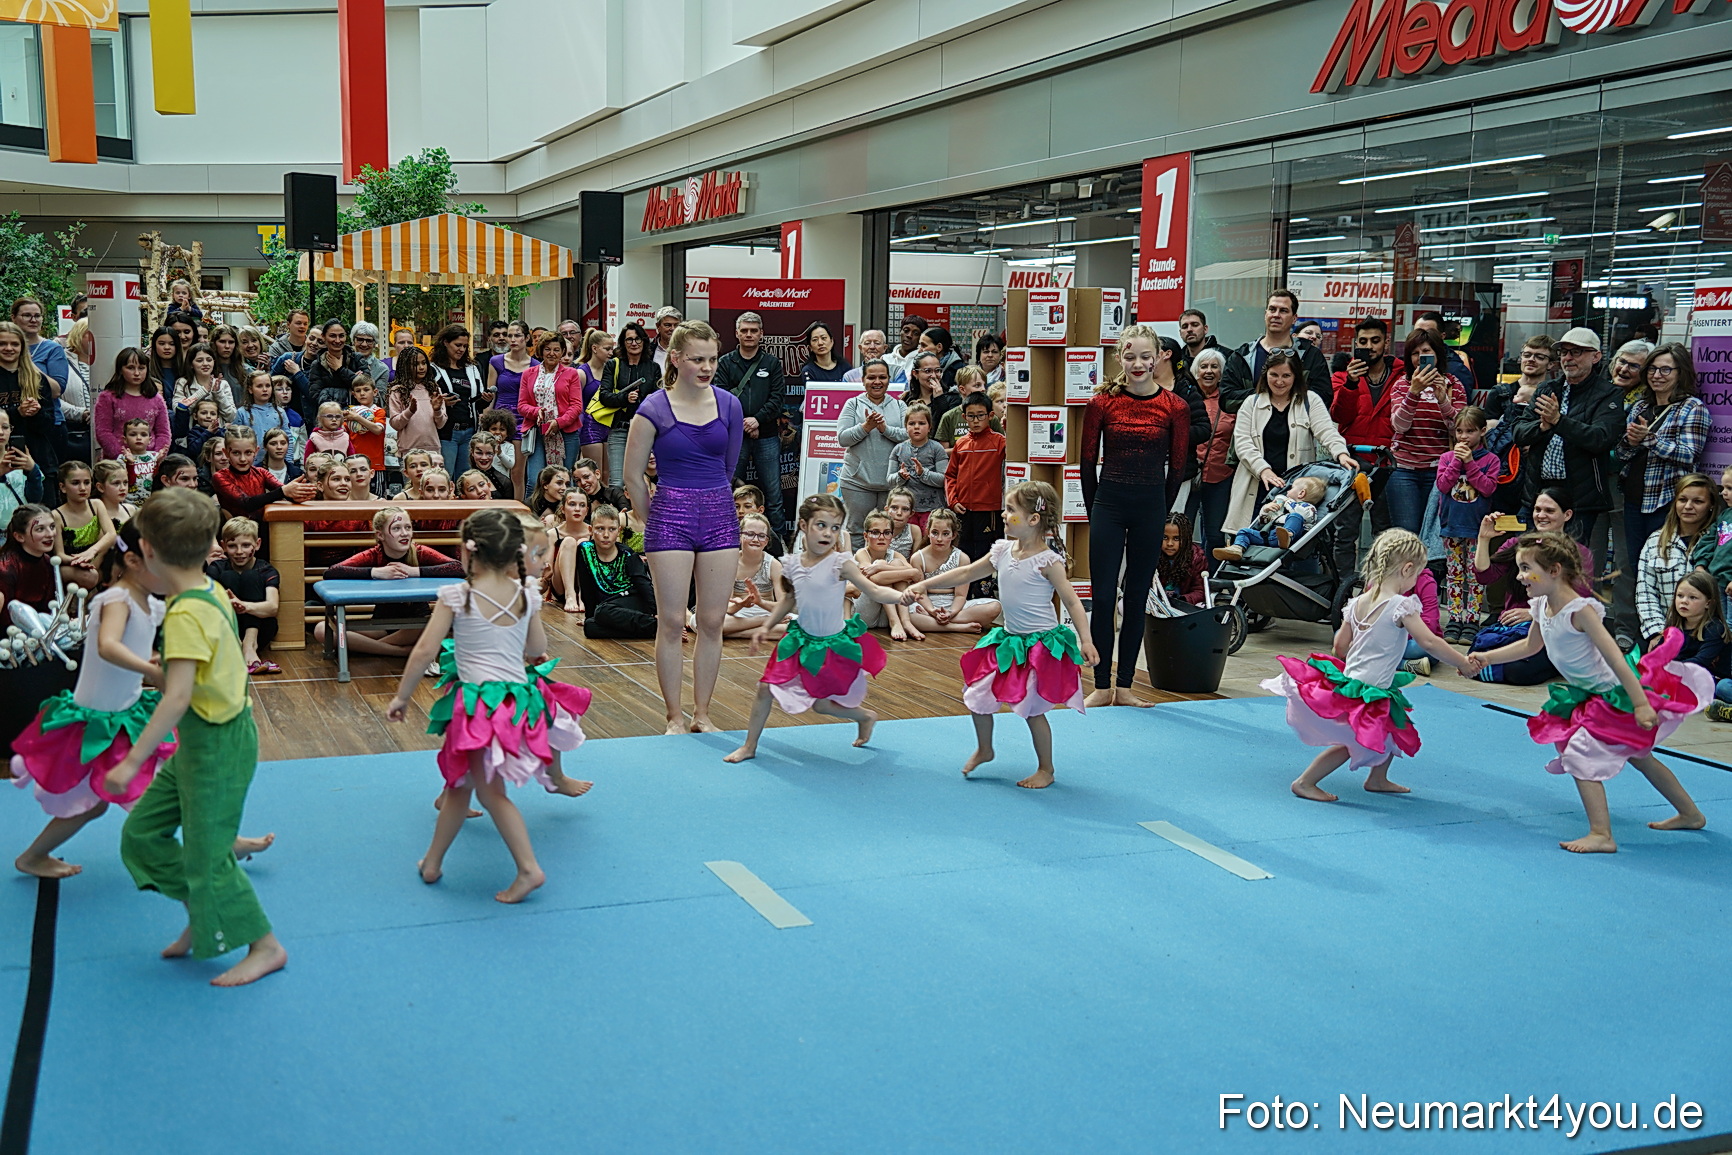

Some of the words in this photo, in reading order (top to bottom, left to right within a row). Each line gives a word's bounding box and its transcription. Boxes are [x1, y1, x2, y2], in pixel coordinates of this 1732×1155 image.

[641, 186, 684, 232] Media
[693, 170, 742, 221] Markt
[1155, 167, 1178, 250] 1
[787, 230, 797, 280] 1
[1148, 257, 1176, 273] Stunde
[742, 288, 774, 298] Media
[1593, 296, 1647, 310] SAMSUNG
